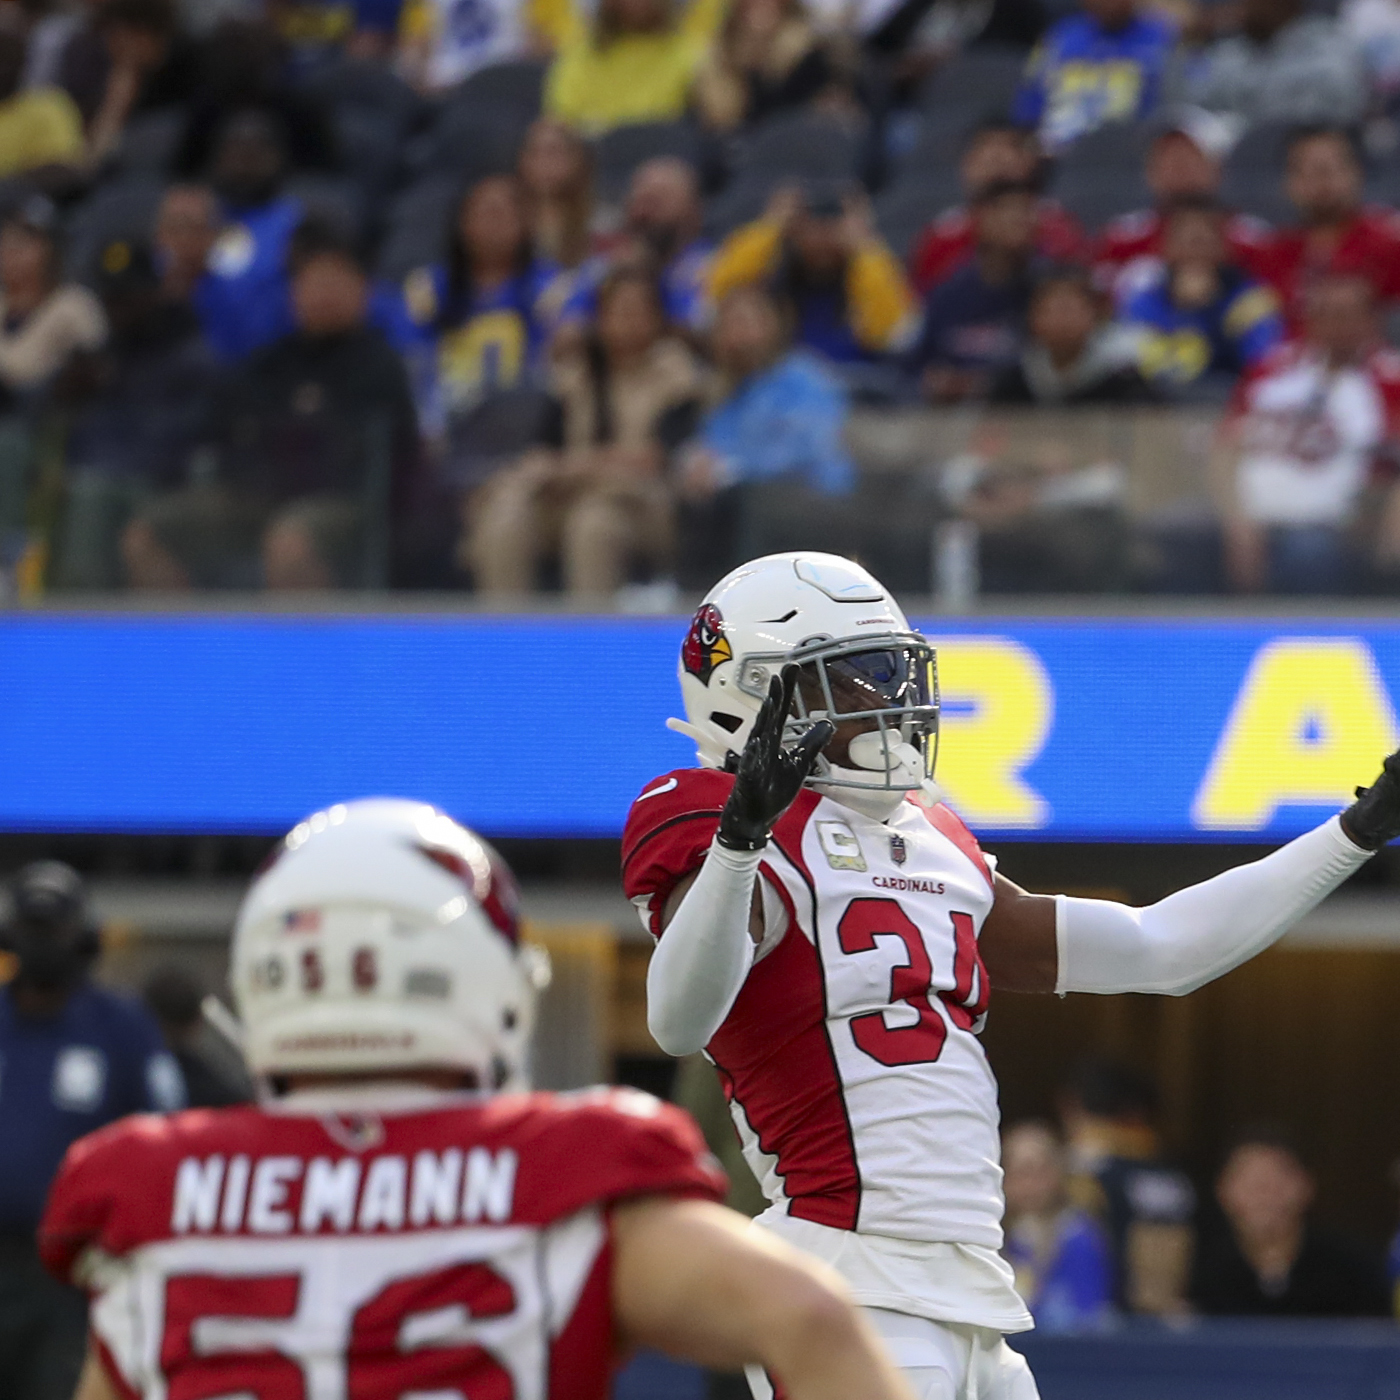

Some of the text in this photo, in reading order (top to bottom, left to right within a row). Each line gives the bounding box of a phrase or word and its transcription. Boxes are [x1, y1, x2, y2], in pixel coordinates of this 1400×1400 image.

[872, 875, 945, 895] CARDINALS
[837, 896, 991, 1067] 34
[170, 1146, 518, 1234] NIEMANN
